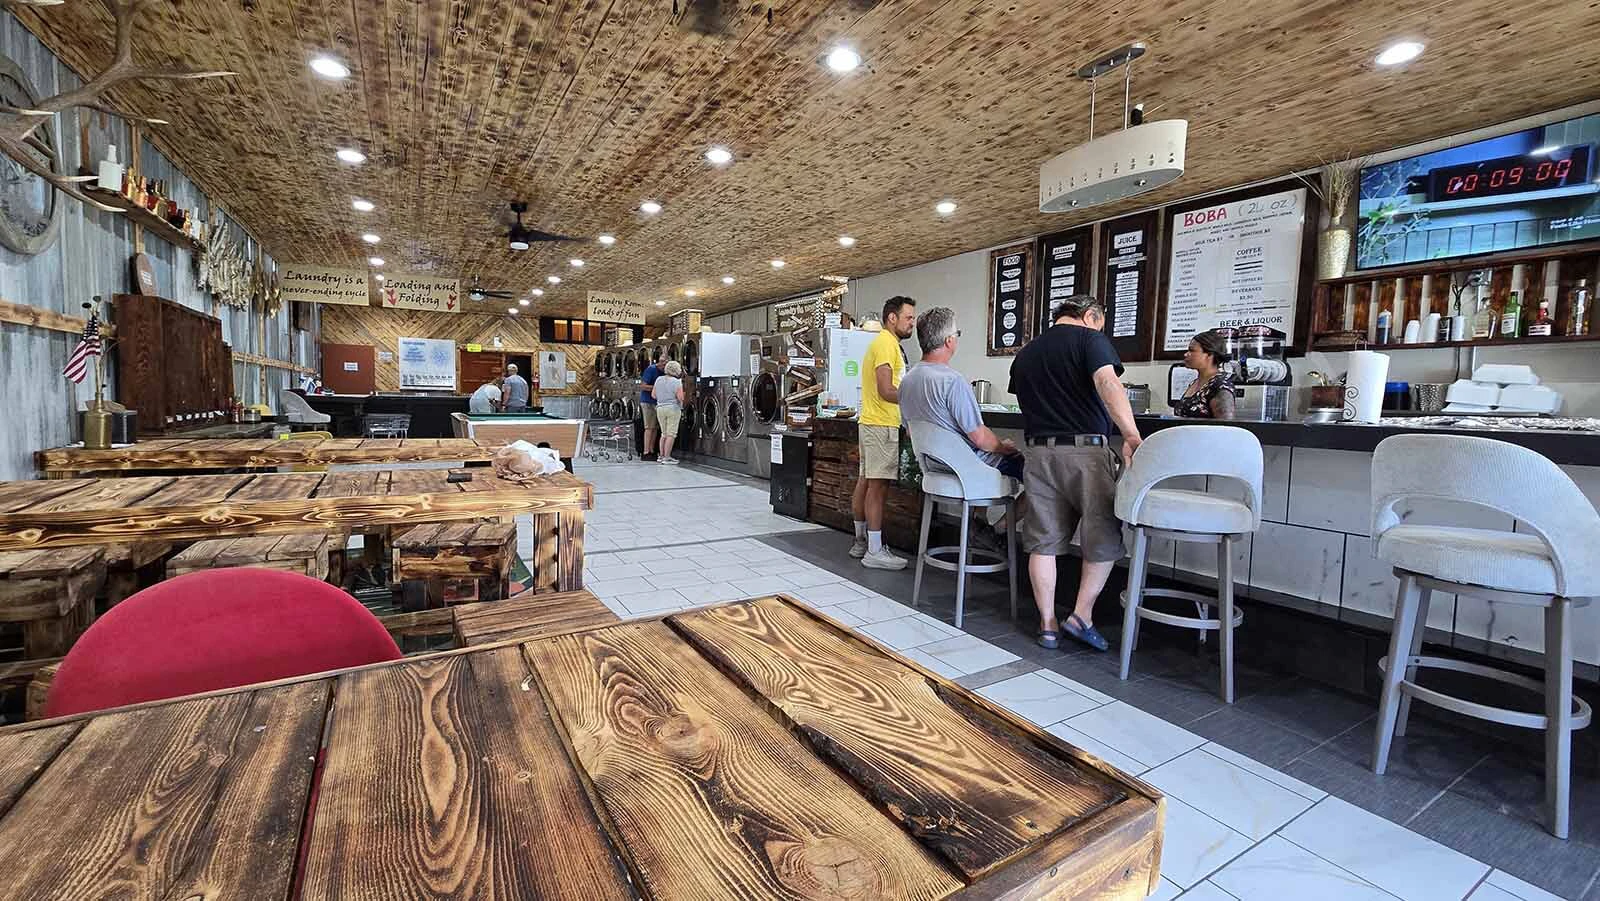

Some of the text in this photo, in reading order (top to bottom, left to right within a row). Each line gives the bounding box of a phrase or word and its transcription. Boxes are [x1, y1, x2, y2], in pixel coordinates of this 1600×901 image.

[1184, 207, 1227, 227] BOBA
[1118, 235, 1137, 245] JUICE
[1236, 247, 1262, 256] COFFEE
[1004, 257, 1019, 265] FOOD
[284, 270, 364, 288] Laundry is a
[281, 286, 343, 299] never-ending
[385, 279, 458, 296] Loading and
[399, 292, 440, 310] Folding
[590, 295, 622, 308] Laundry
[593, 306, 614, 318] loads
[624, 309, 640, 321] fun
[1220, 315, 1282, 328] BEER & LIQUOR
